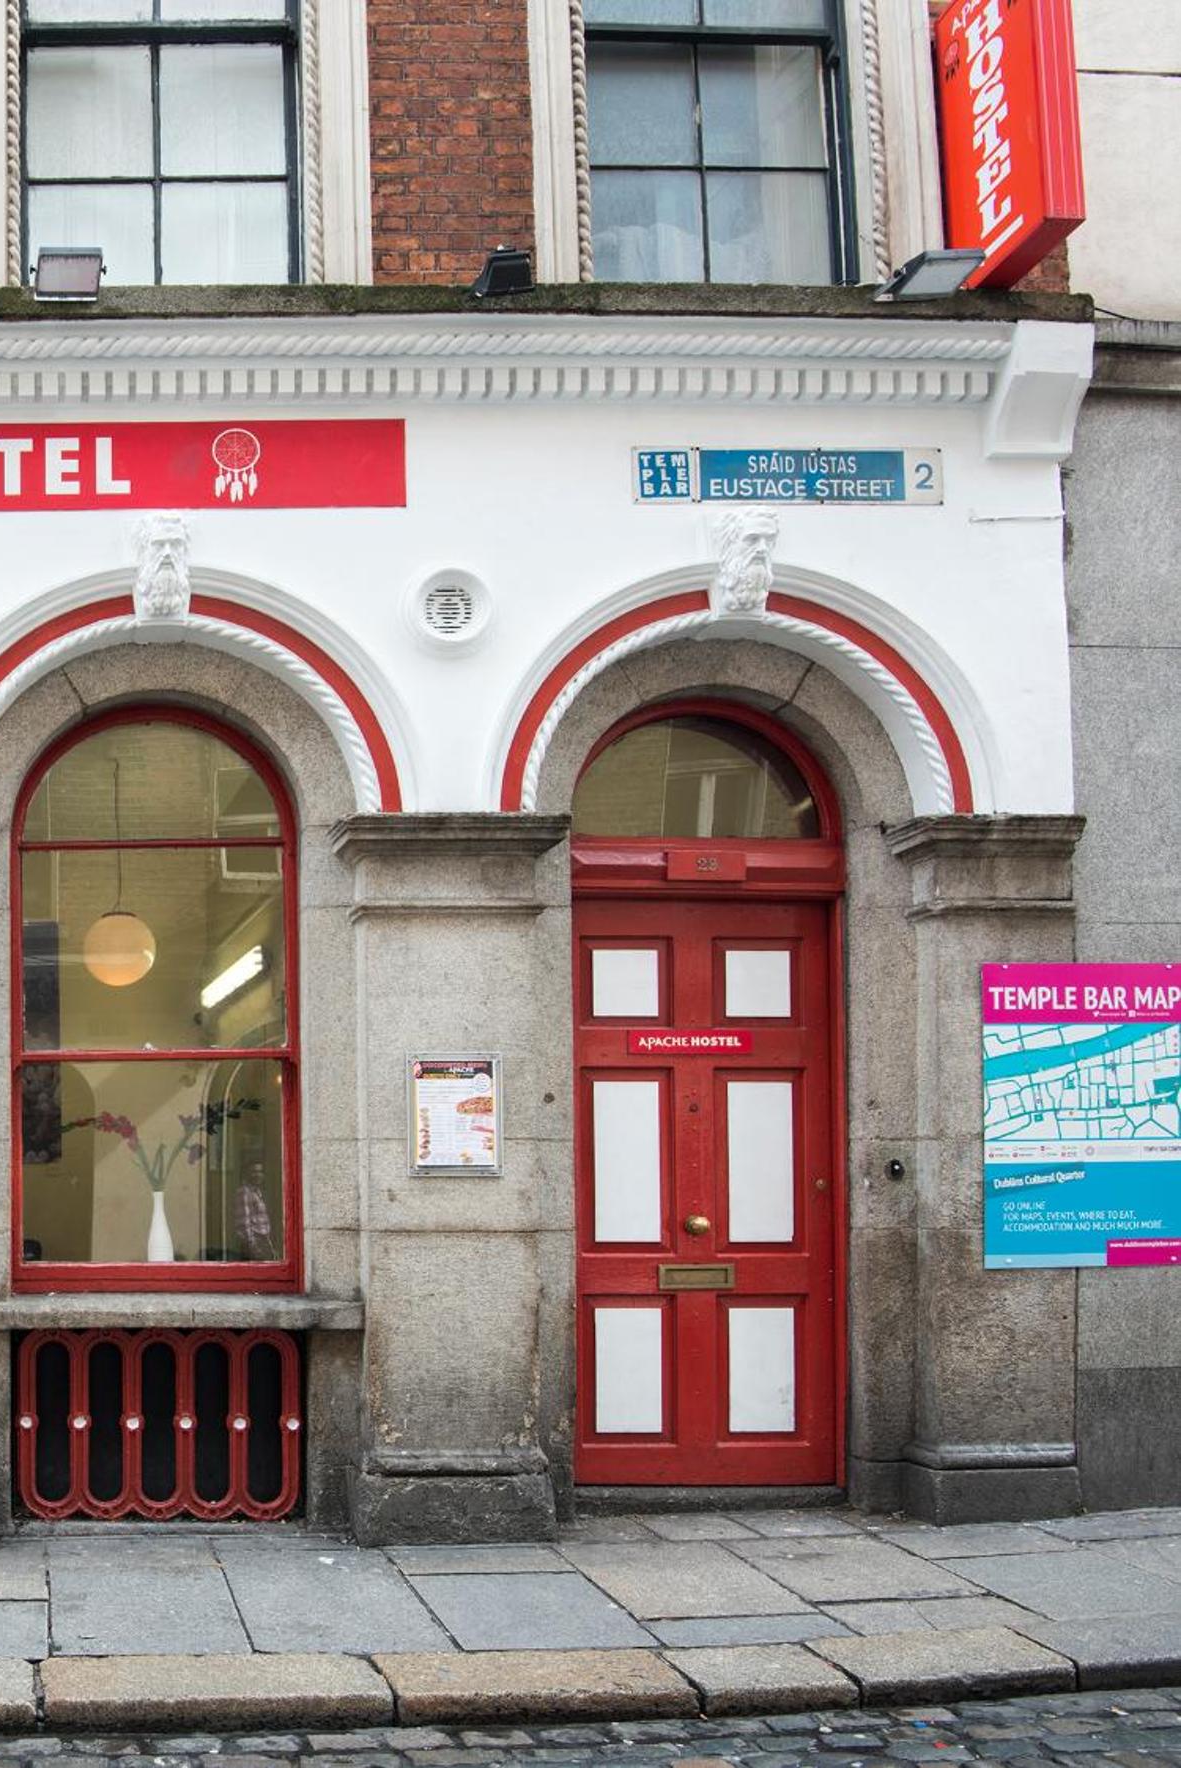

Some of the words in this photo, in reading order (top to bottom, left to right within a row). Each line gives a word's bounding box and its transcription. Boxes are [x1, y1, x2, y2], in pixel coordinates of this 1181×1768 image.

[966, 0, 1012, 240] HOSTEL
[640, 454, 687, 467] TEM
[748, 452, 795, 473] SRÁID
[803, 452, 857, 473] IÚSTAS
[641, 468, 688, 481] PLE
[914, 463, 934, 490] 2
[643, 482, 688, 495] BAR
[710, 478, 807, 497] EUSTACE
[815, 479, 895, 497] STREET
[989, 986, 1077, 1010] TEMPLE
[1084, 986, 1128, 1010] BAR
[1134, 986, 1181, 1010] MAP
[639, 1036, 689, 1050] APACHE
[691, 1036, 742, 1047] HOSTEL
[1056, 1170, 1085, 1183] Quarter
